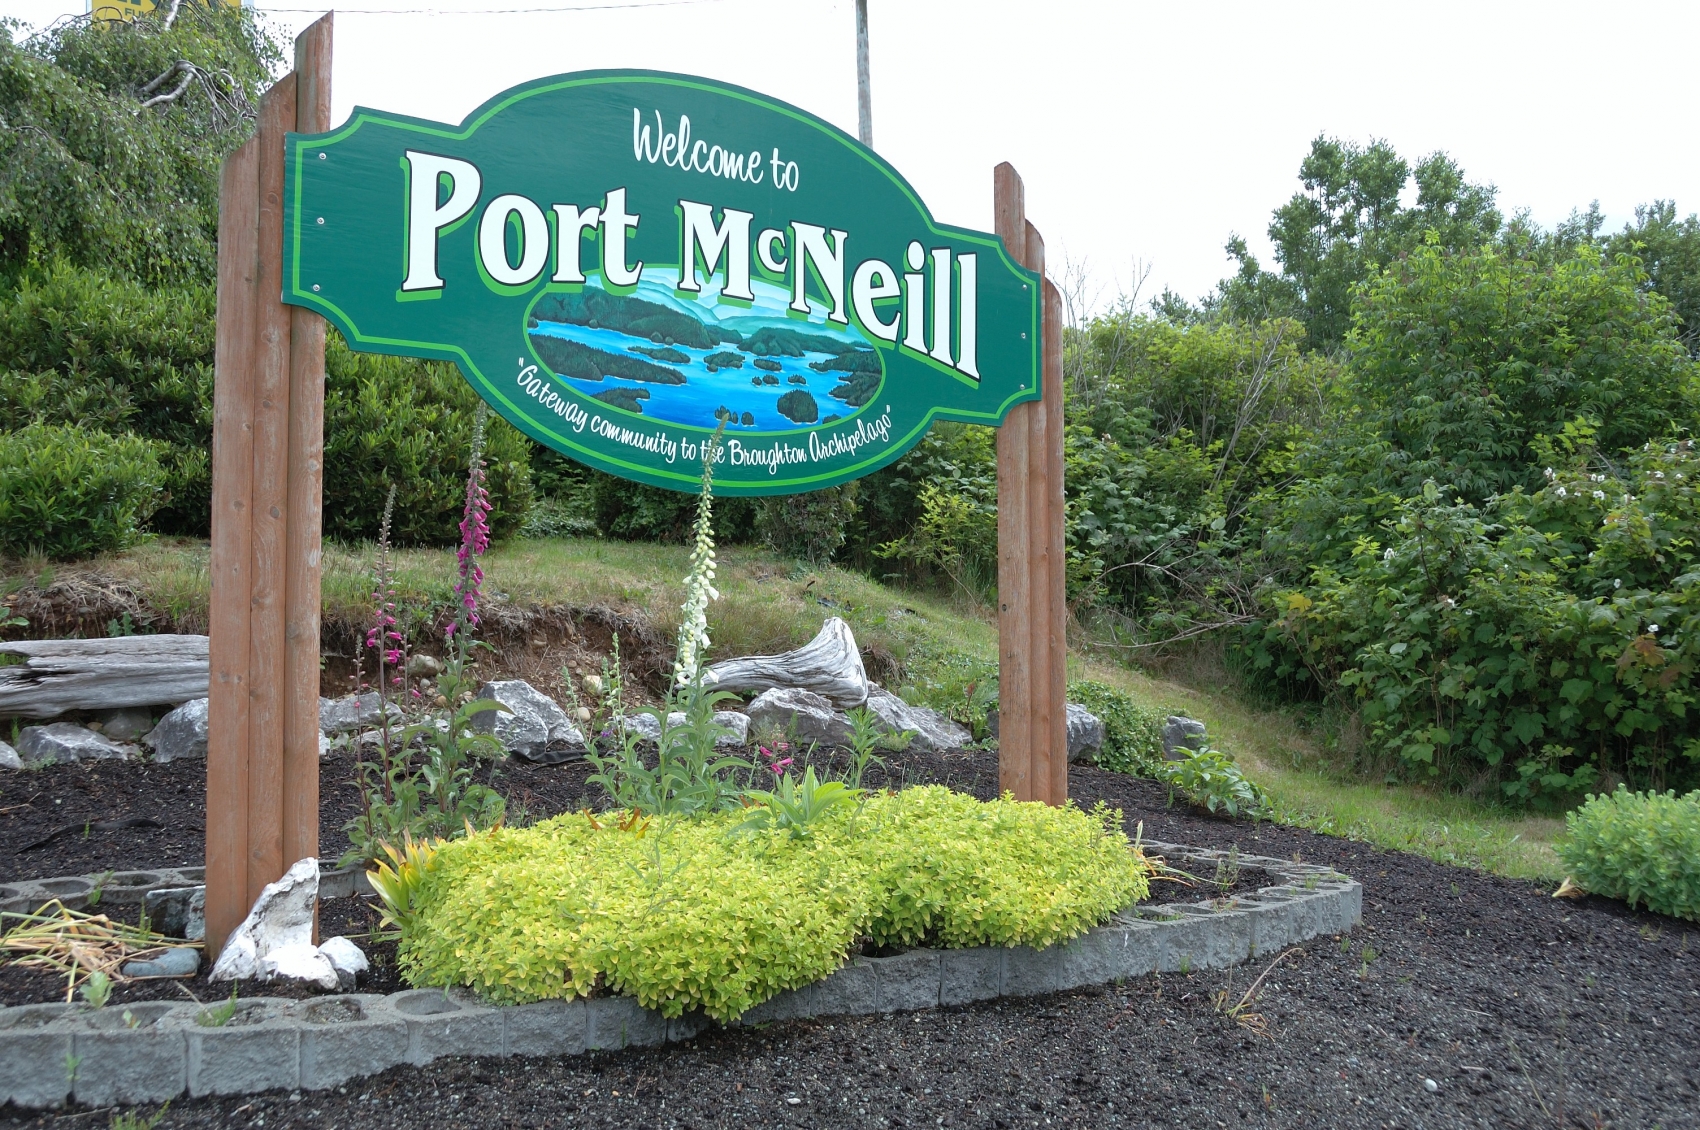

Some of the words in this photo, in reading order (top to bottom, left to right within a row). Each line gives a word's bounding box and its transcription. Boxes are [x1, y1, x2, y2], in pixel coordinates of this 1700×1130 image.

[633, 107, 764, 184] Welcome
[770, 147, 800, 192] to
[401, 149, 645, 292] Port
[676, 199, 981, 384] McNeill
[516, 356, 588, 433] "Gateway
[590, 413, 677, 464] community
[681, 437, 697, 460] to
[727, 438, 807, 475] Broughton
[808, 404, 892, 463] Archipelago"
